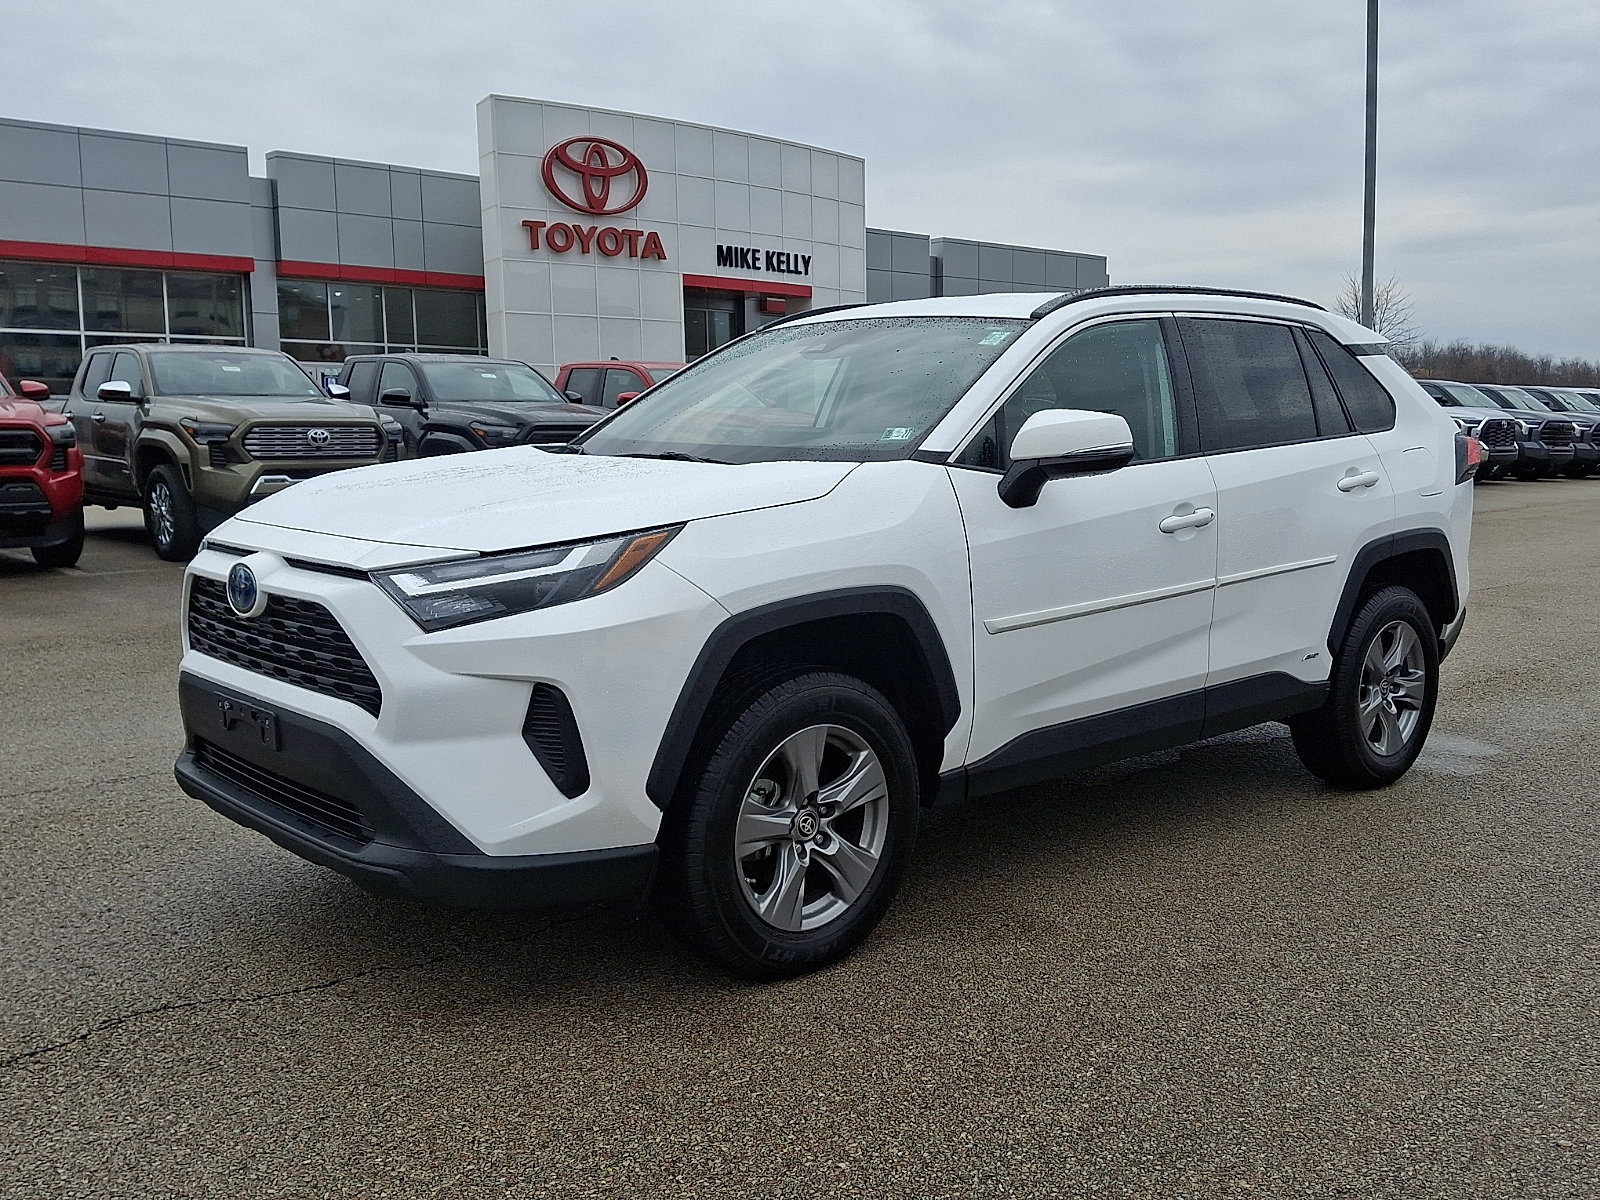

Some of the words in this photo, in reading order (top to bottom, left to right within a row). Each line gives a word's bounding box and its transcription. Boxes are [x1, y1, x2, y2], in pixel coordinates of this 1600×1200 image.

[522, 220, 667, 260] TOYOTA
[716, 244, 762, 271] MIKE
[765, 250, 812, 276] KELLY
